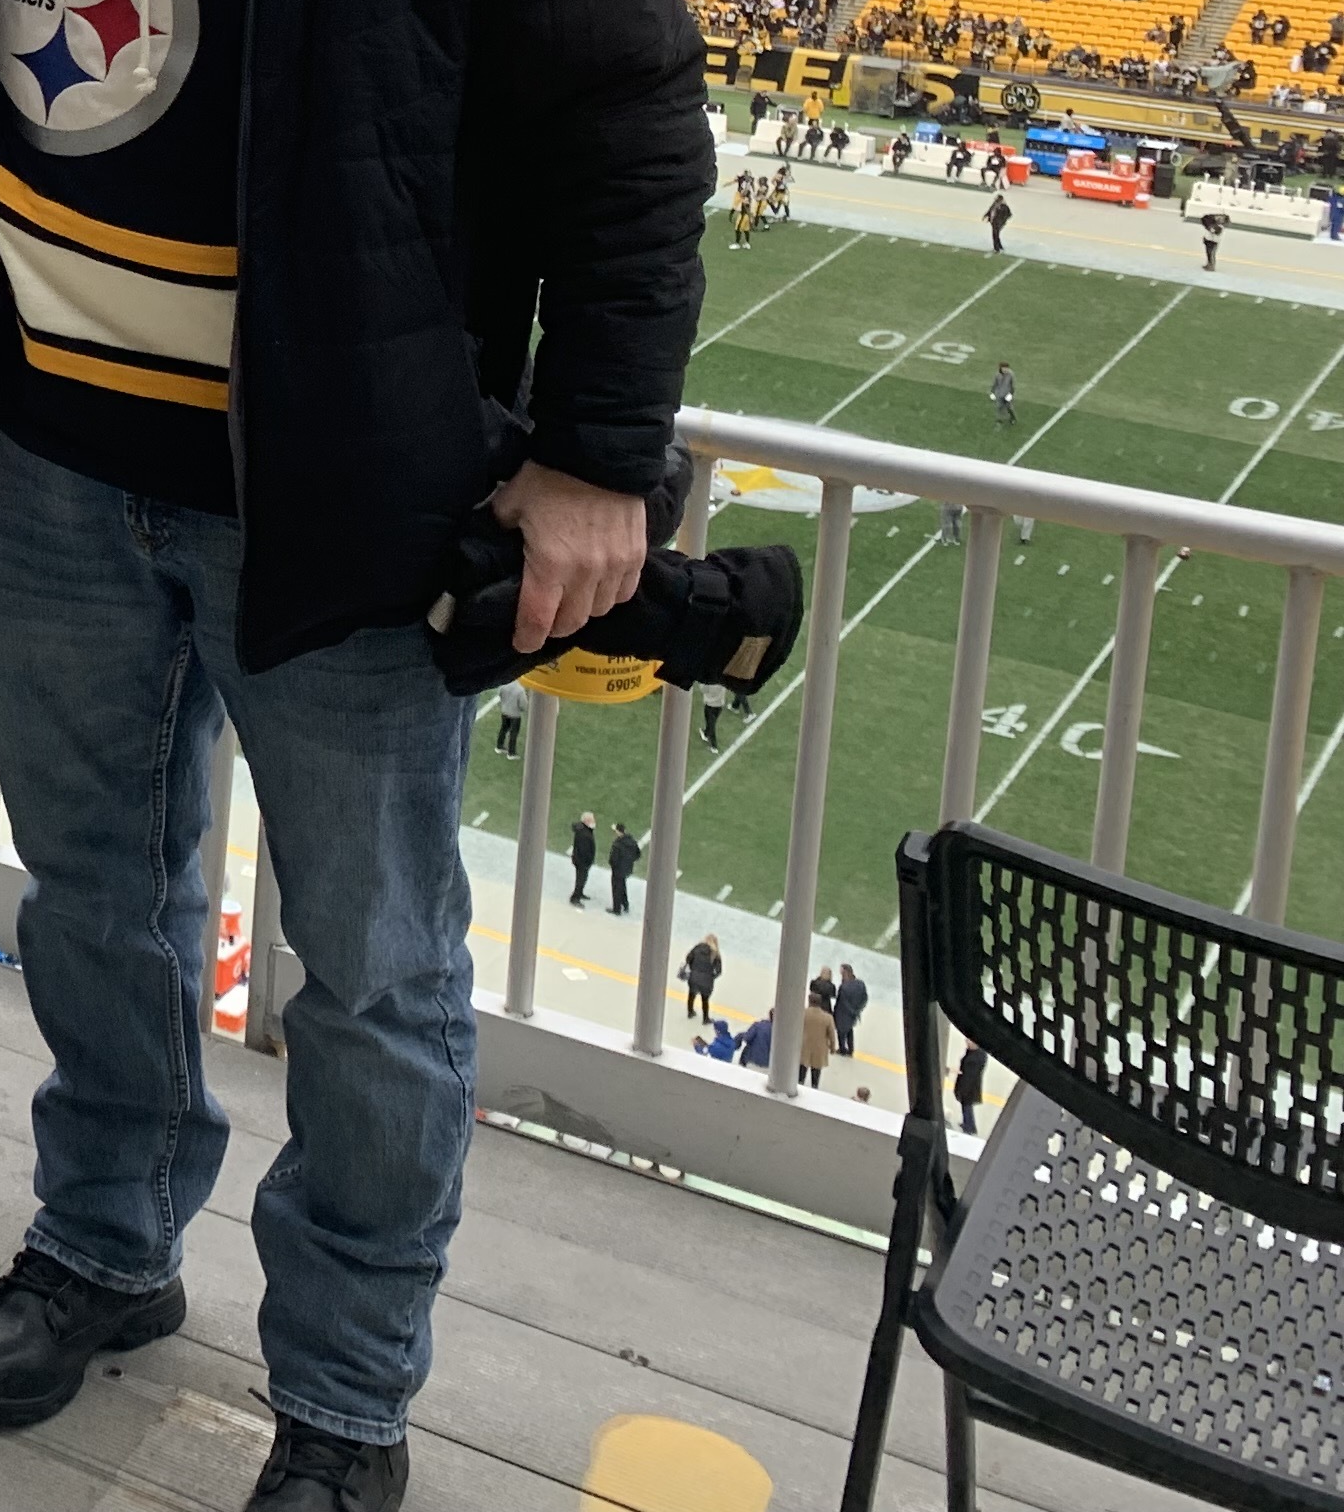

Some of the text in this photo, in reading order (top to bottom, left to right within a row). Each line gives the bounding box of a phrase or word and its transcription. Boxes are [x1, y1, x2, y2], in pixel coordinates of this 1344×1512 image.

[858, 329, 976, 365] 50
[575, 665, 597, 675] YOUR
[598, 665, 631, 676] LOCATION
[606, 675, 642, 692] 69050
